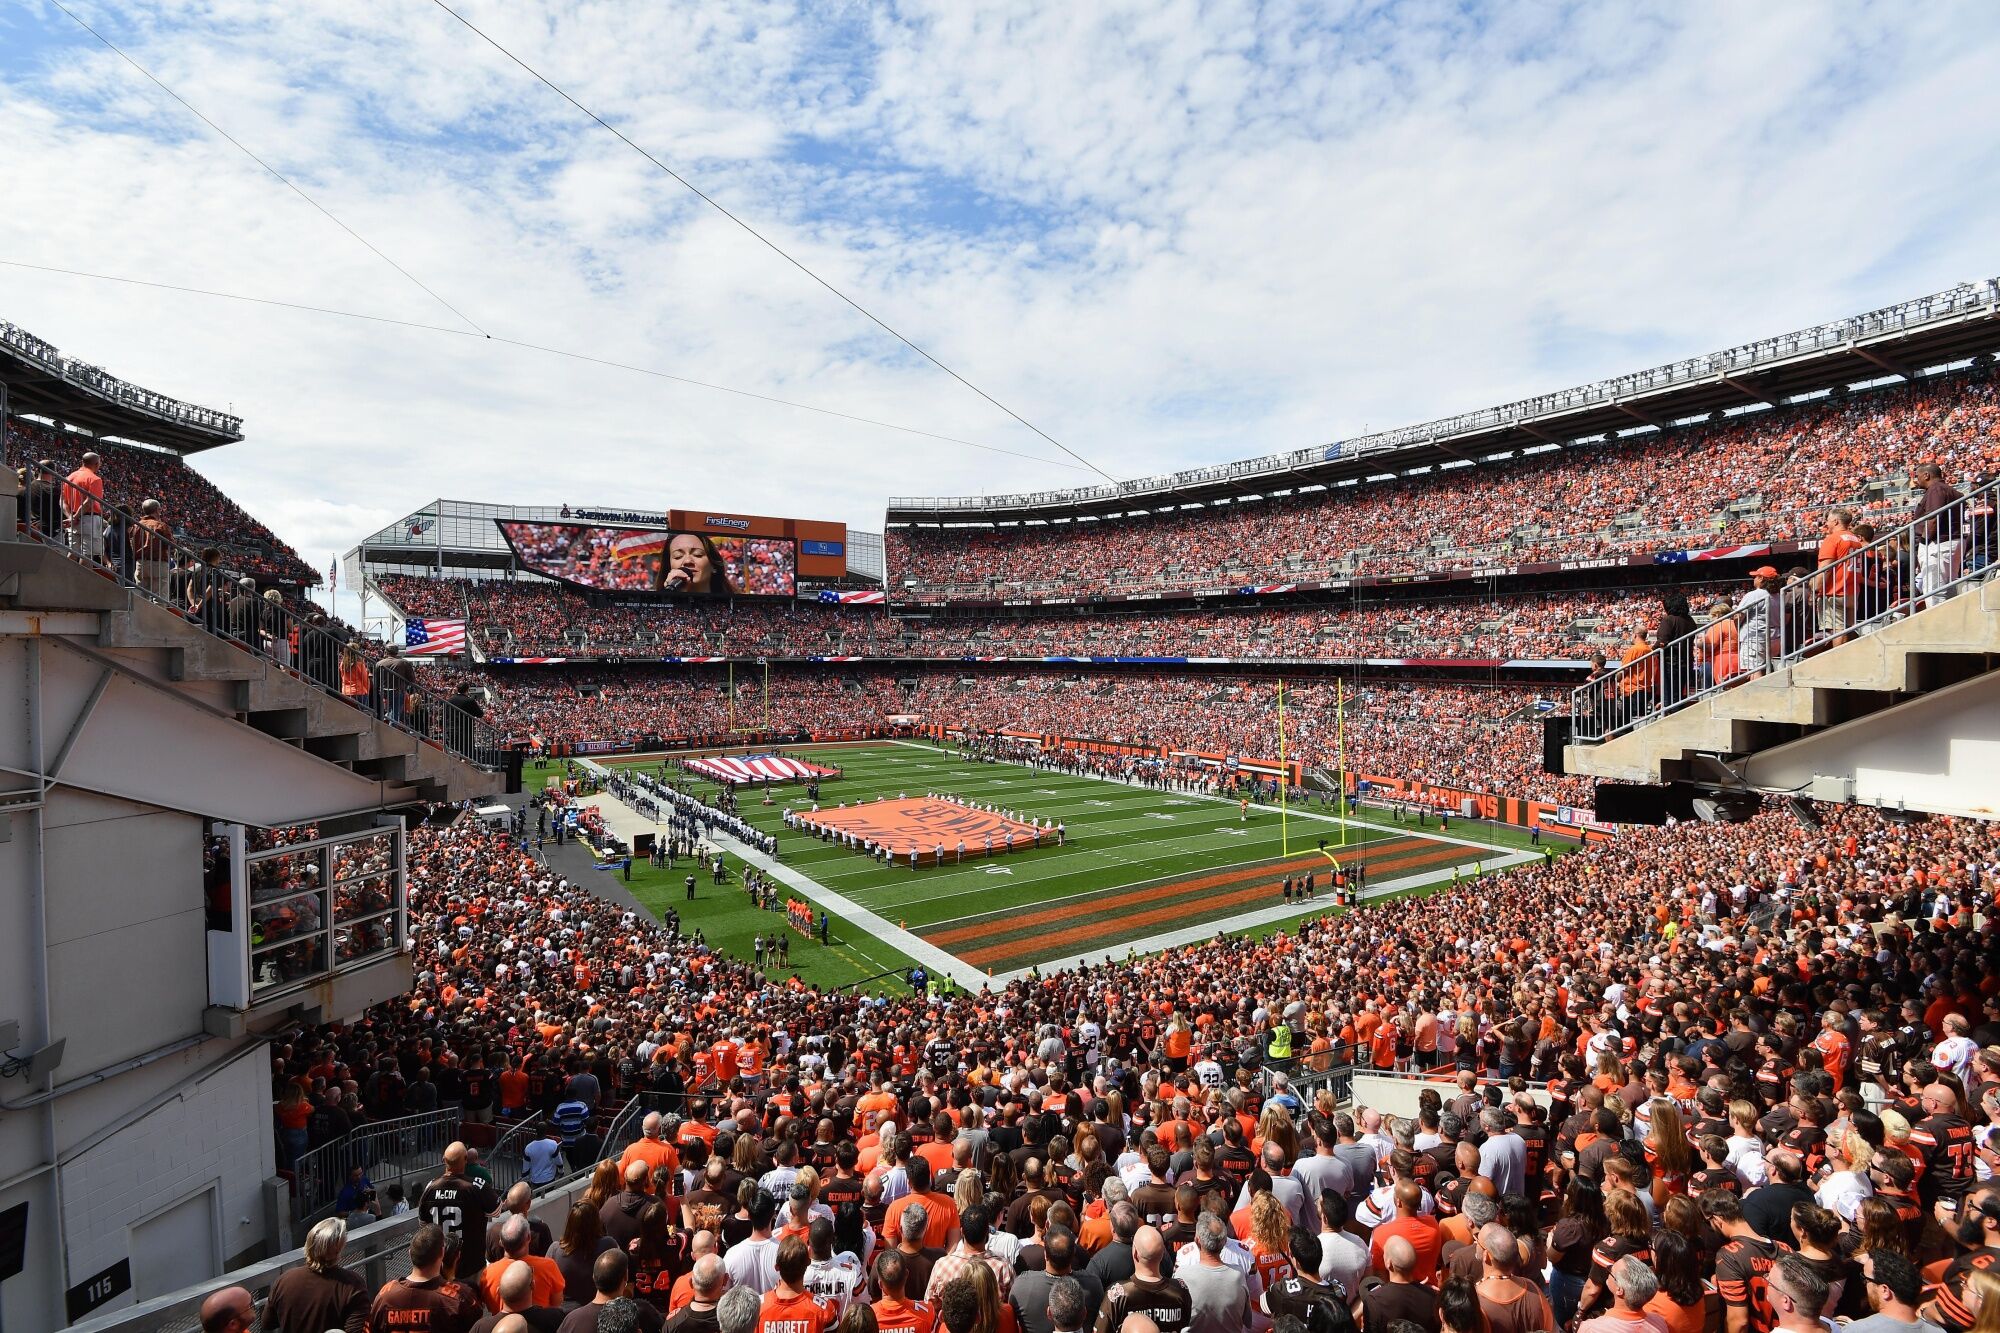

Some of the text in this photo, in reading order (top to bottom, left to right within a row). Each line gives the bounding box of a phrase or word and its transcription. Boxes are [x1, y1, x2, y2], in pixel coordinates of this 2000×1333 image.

[1344, 433, 1404, 453] FirstEnergy
[706, 516, 750, 529] FirstEnergy
[1798, 540, 1816, 550] LOU
[1561, 557, 1628, 570] PAUL WARFIELD 42
[1471, 567, 1518, 578] JIM BROWN 32
[588, 743, 610, 751] KICKOFF
[1120, 1034, 1127, 1047] 6
[934, 1051, 951, 1067] 32
[682, 1134, 703, 1142] MAYF
[1947, 1126, 1970, 1139] THOMAS
[1223, 1160, 1250, 1170] MAYFIELD
[1947, 1142, 1974, 1179] 73
[1411, 1164, 1433, 1175] FIELD
[472, 1176, 486, 1190] 12
[773, 1184, 795, 1193] JOHNS
[435, 1189, 457, 1200] McCOY
[828, 1192, 853, 1202] BECKHAM
[429, 1206, 463, 1239] 12
[1260, 1253, 1289, 1265] BECKHA
[1750, 1256, 1774, 1272] GARR
[1971, 1254, 1995, 1270] 6
[635, 1269, 670, 1293] 24
[88, 1275, 112, 1302] 115
[803, 1281, 845, 1296] CKHAM JR
[388, 1310, 431, 1325] GARRETT
[1153, 1307, 1182, 1322] POUND
[764, 1320, 809, 1333] GARRETT
